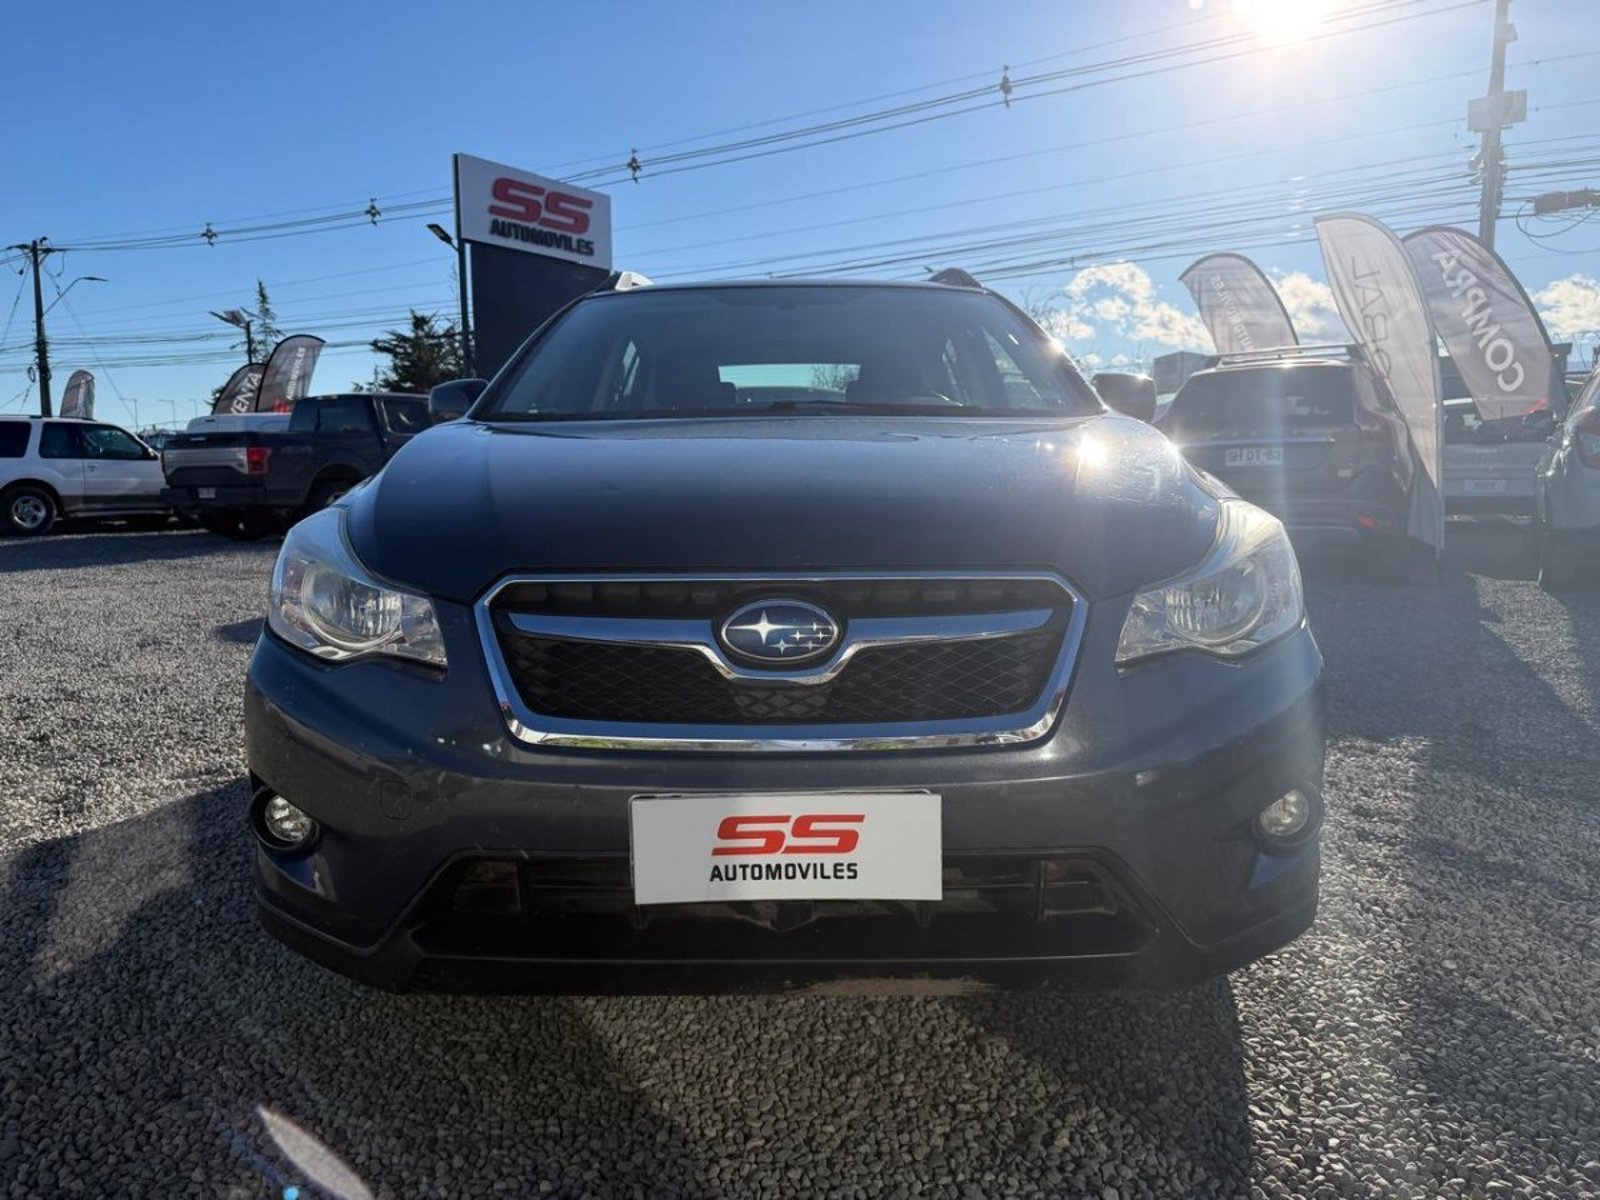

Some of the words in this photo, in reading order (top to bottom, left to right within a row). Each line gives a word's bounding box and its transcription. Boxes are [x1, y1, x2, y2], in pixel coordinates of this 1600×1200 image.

[489, 177, 593, 235] SS
[490, 218, 594, 256] AUTOMOVILES
[711, 814, 865, 856] SS
[710, 862, 858, 882] AUTOMOVILES
